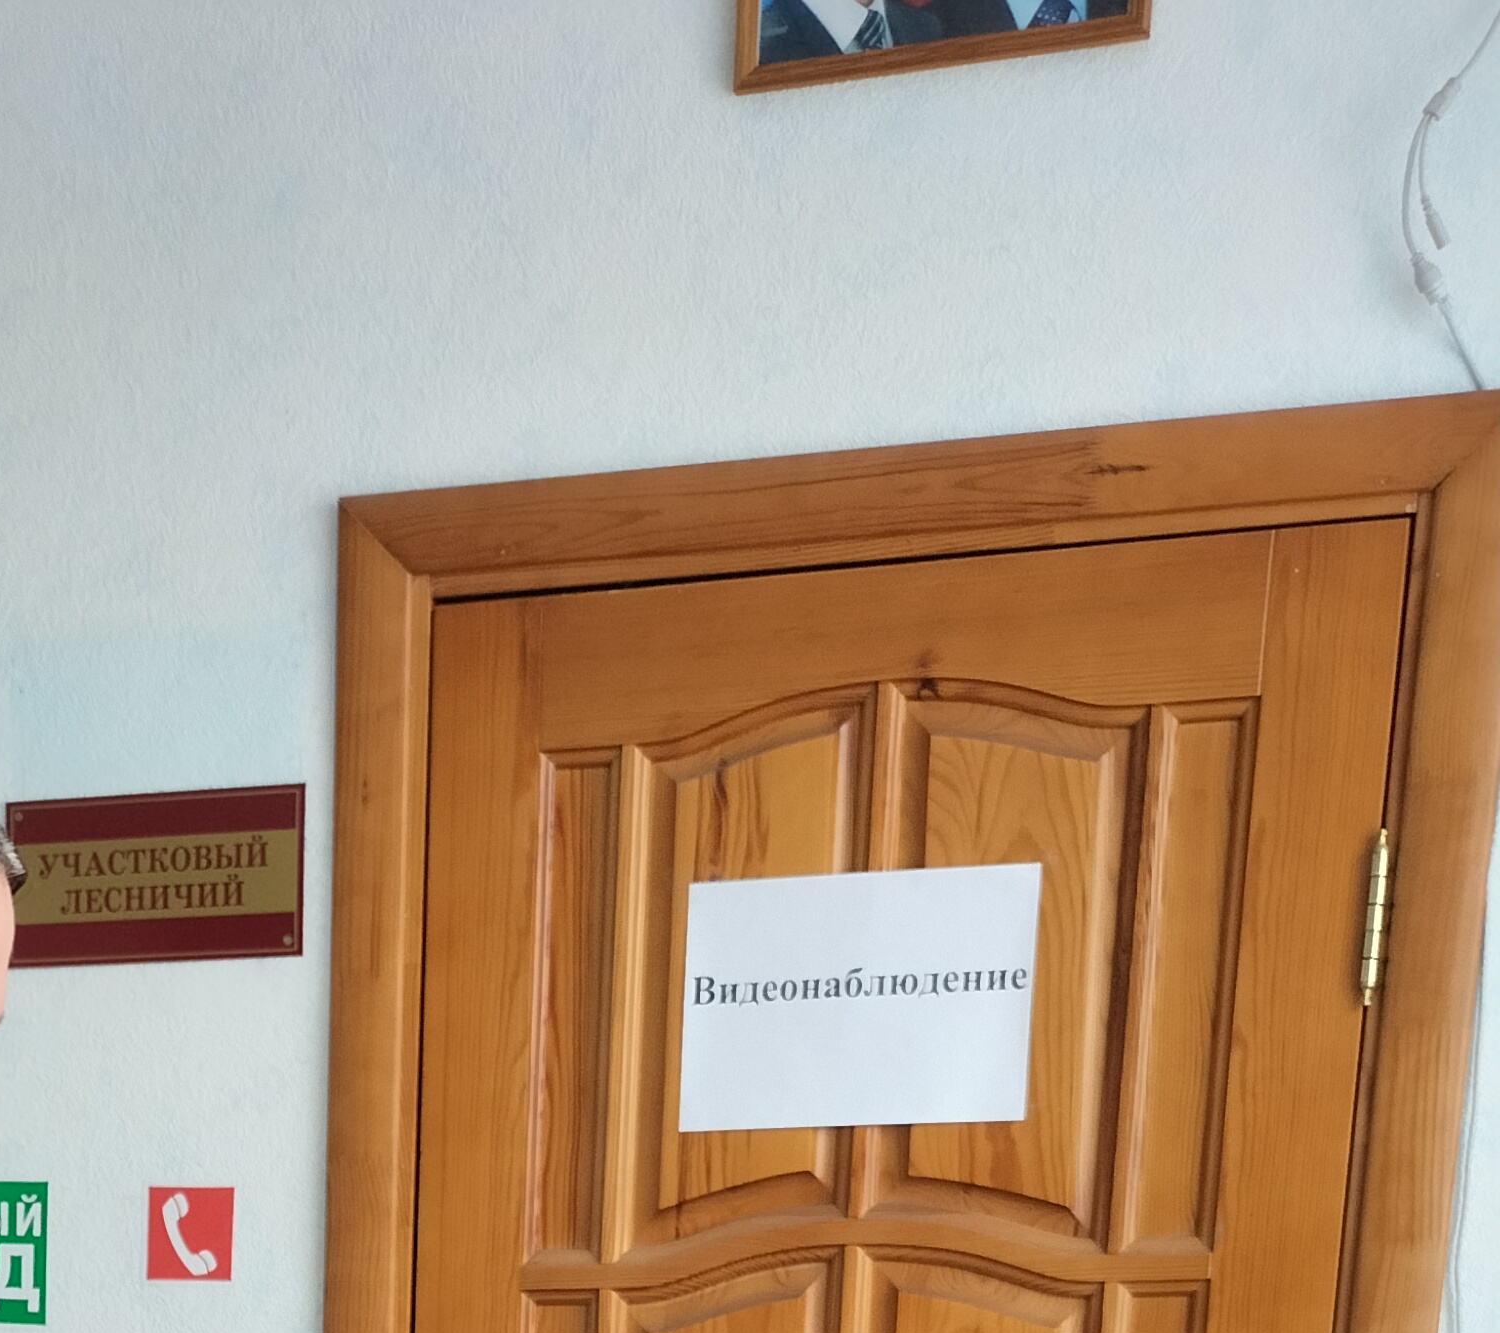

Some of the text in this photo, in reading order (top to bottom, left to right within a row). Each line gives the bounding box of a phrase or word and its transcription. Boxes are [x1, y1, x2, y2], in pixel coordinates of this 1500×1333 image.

[38, 835, 269, 880] УЧАСТКОВЫЙ
[60, 874, 245, 915] ЛЕСНИЧИЙ
[692, 967, 1028, 1006] Видеонаблюдение
